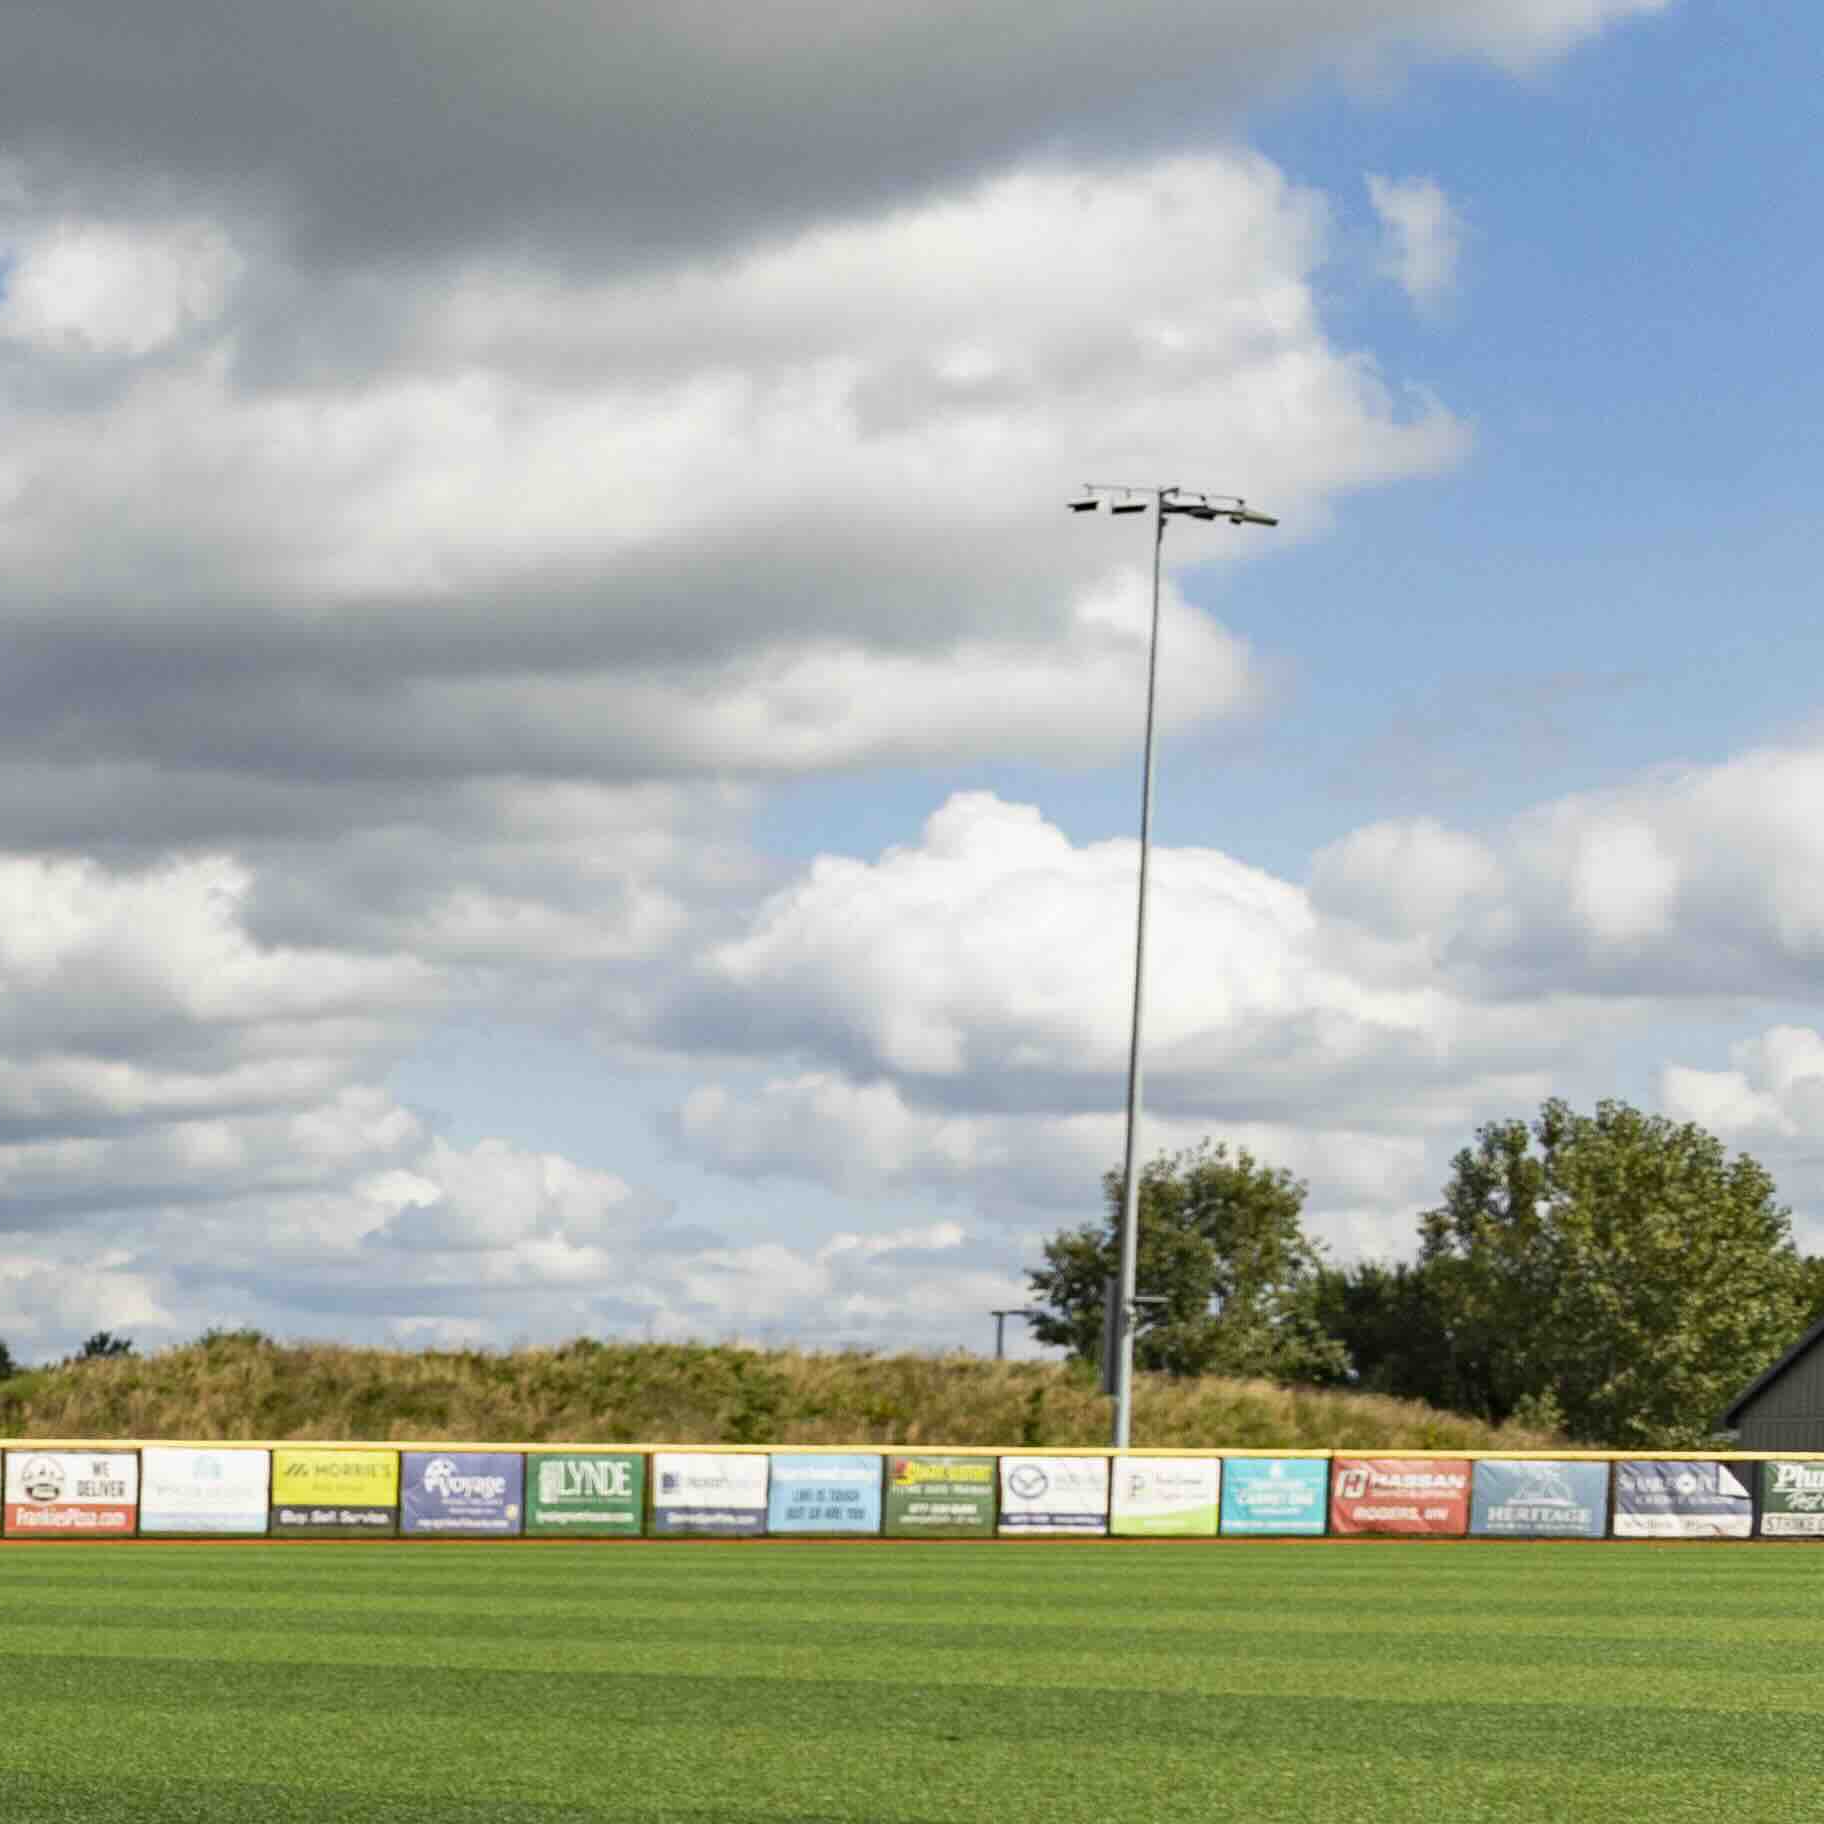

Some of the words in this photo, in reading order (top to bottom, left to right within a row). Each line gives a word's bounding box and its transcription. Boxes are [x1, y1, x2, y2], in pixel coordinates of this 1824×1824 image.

[92, 1461, 111, 1476] WE
[559, 1459, 634, 1497] LYNDE
[76, 1479, 126, 1498] DELIVER
[1488, 1506, 1592, 1524] HERITAGE
